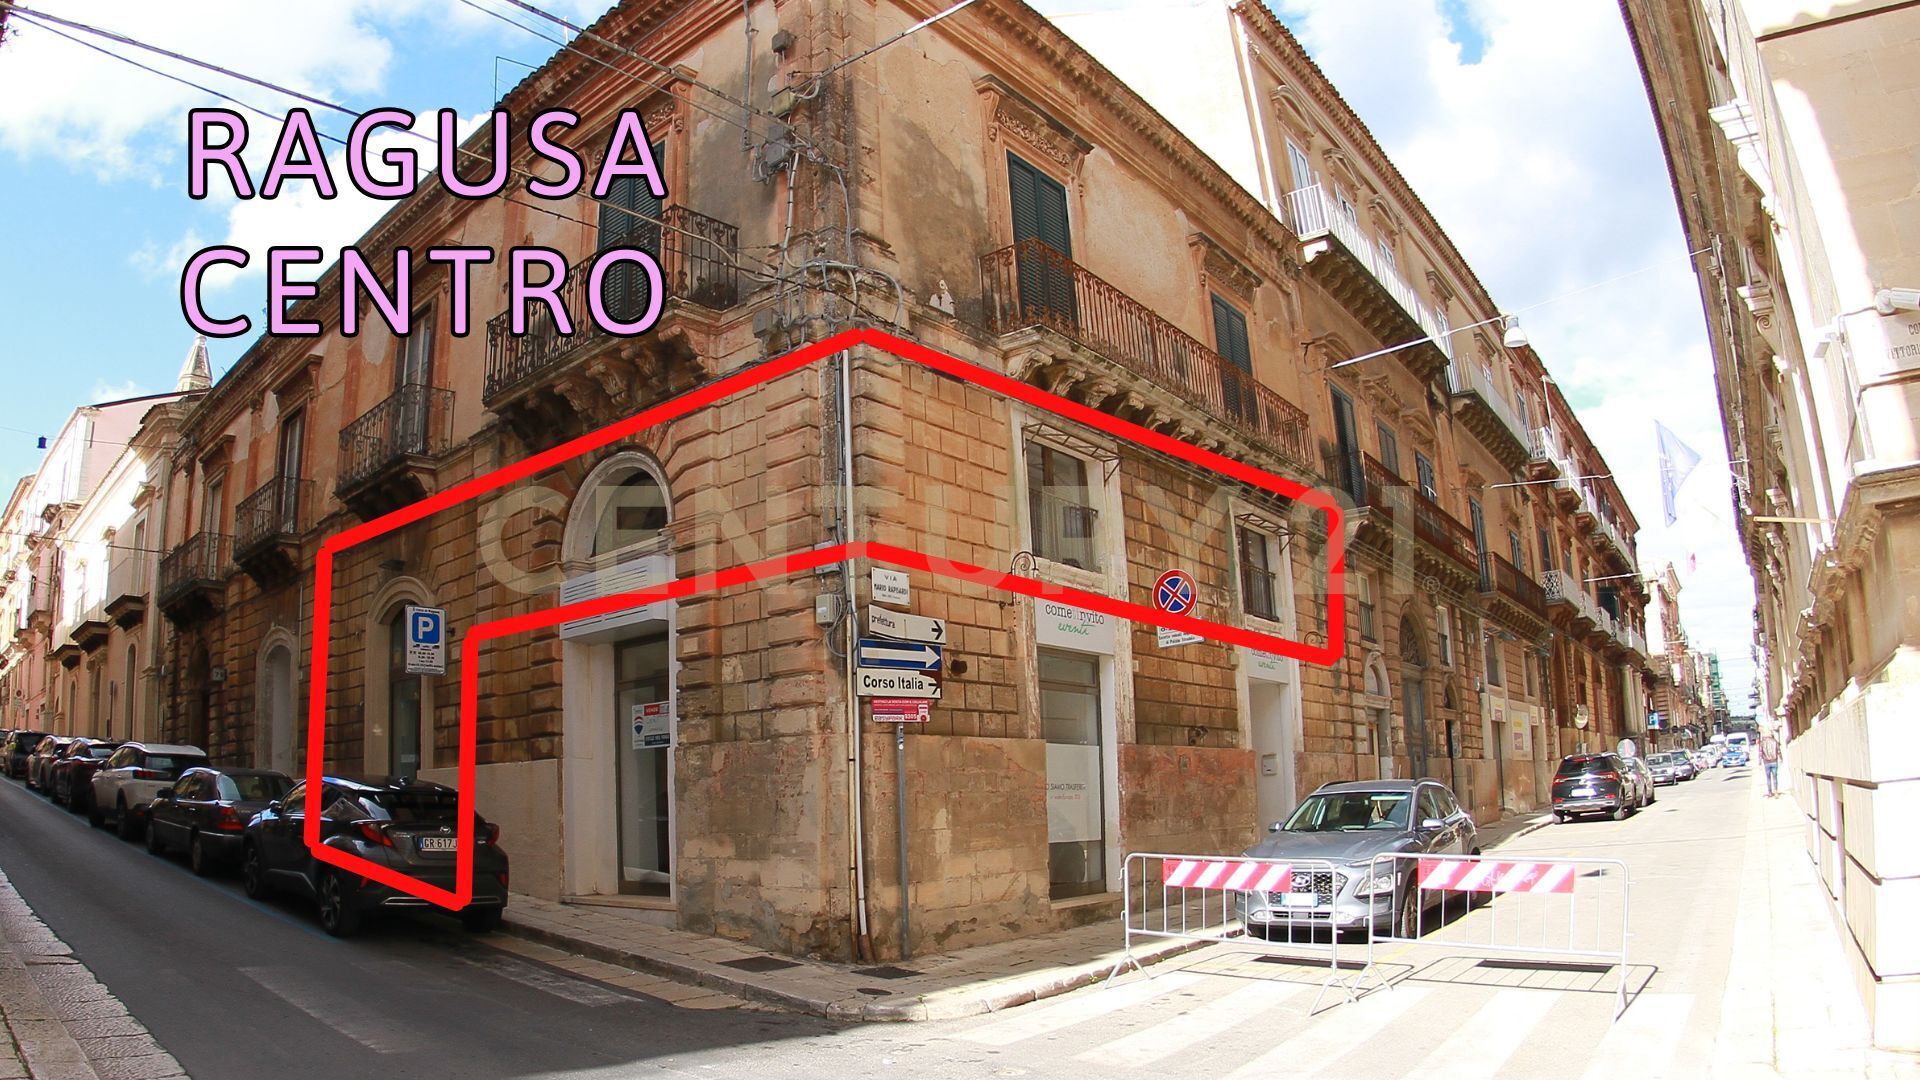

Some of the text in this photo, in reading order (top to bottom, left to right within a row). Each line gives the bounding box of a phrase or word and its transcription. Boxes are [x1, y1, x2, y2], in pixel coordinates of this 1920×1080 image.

[418, 616, 434, 640] P
[871, 614, 896, 629] prefettura
[863, 674, 924, 690] Corso Italia
